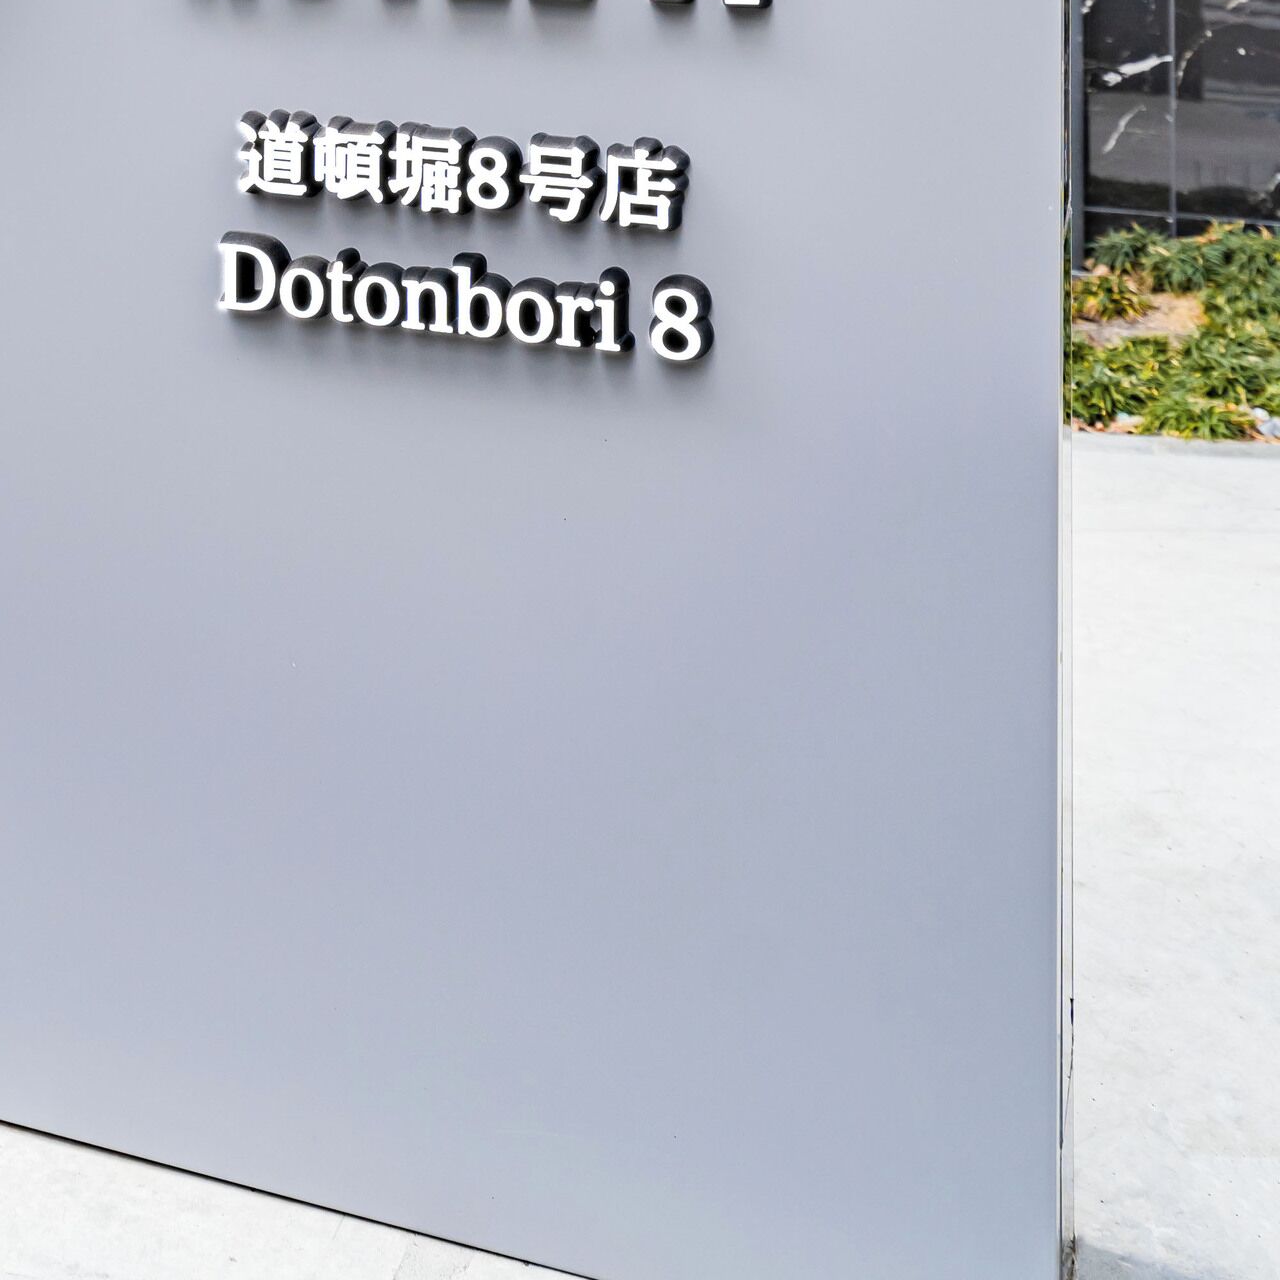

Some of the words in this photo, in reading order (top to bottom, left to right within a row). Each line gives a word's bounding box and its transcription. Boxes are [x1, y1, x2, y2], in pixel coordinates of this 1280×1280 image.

[237, 108, 691, 232] 道頓堀8号店
[218, 231, 636, 354] Dotonbori
[649, 273, 715, 363] 8
